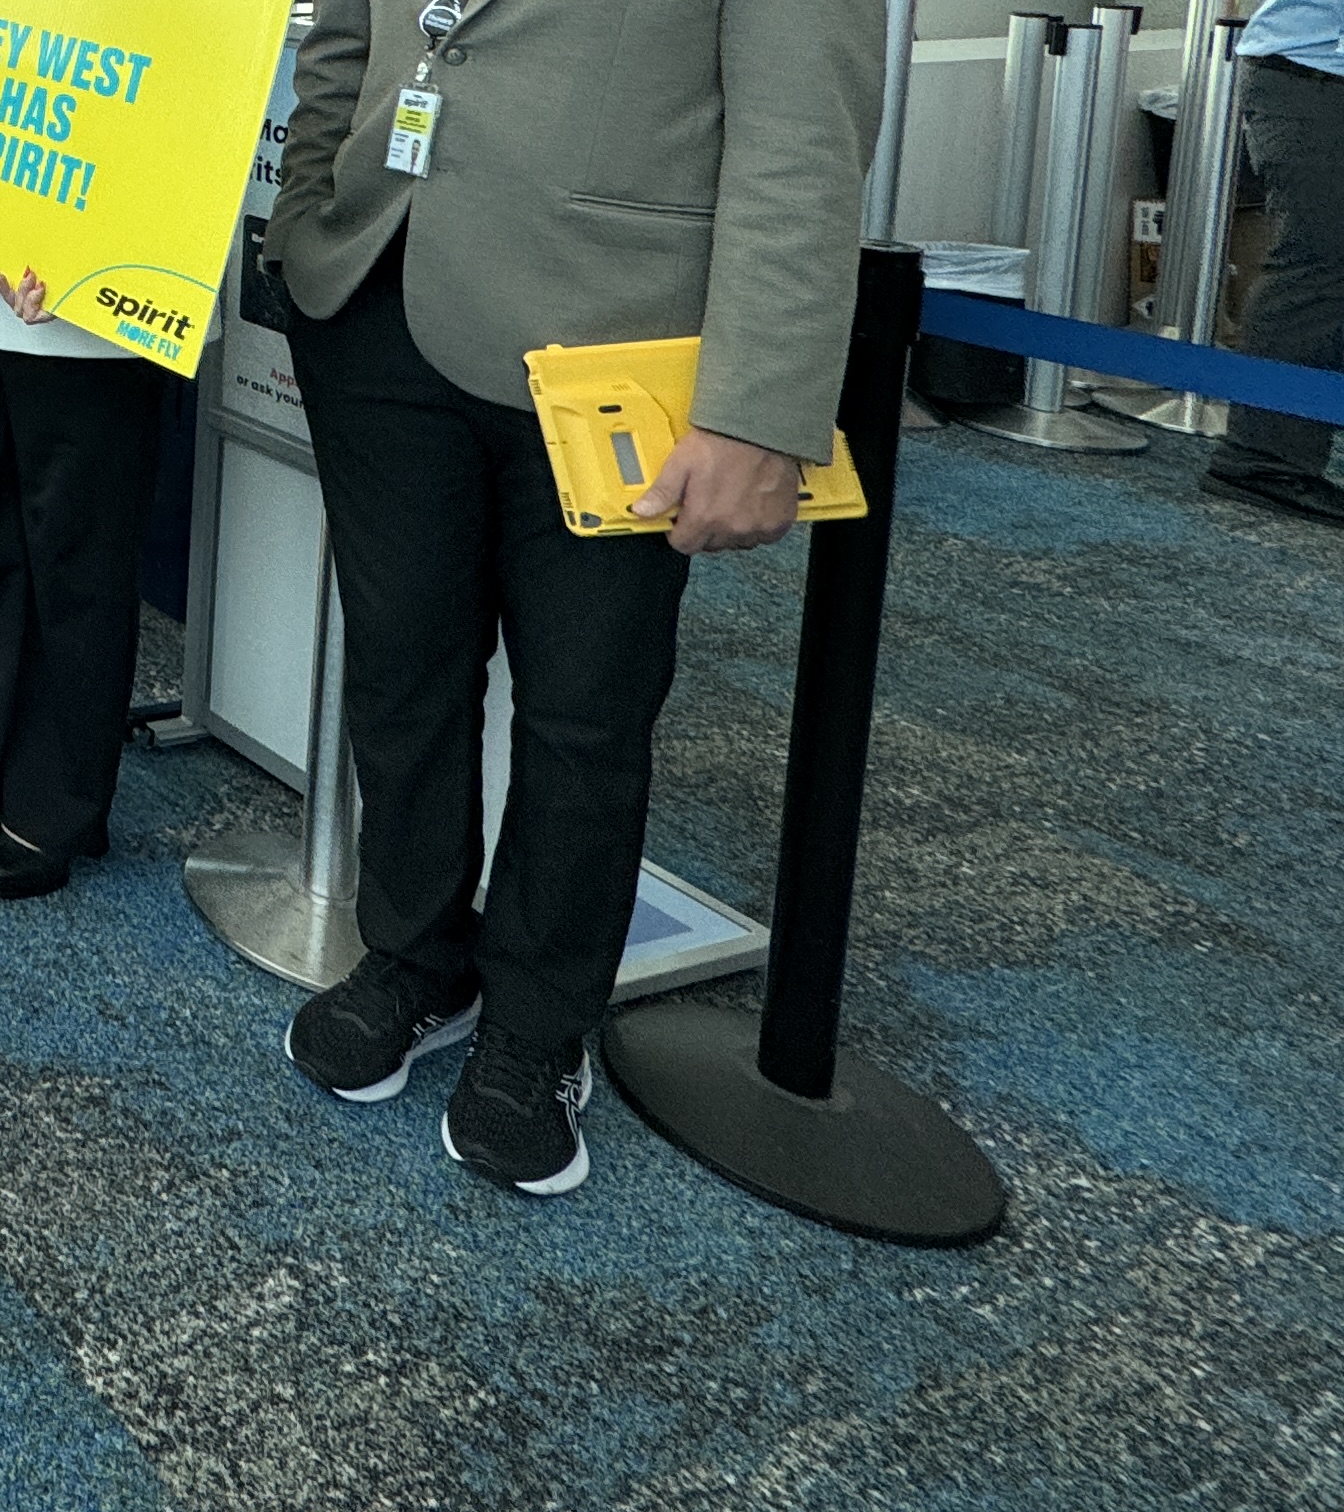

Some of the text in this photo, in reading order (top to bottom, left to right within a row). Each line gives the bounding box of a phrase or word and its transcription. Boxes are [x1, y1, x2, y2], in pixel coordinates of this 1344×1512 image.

[36, 29, 153, 105] WEST
[95, 287, 190, 341] spirit
[157, 337, 183, 361] FLY
[236, 375, 249, 386] or
[251, 381, 274, 397] ask
[270, 367, 297, 387] App
